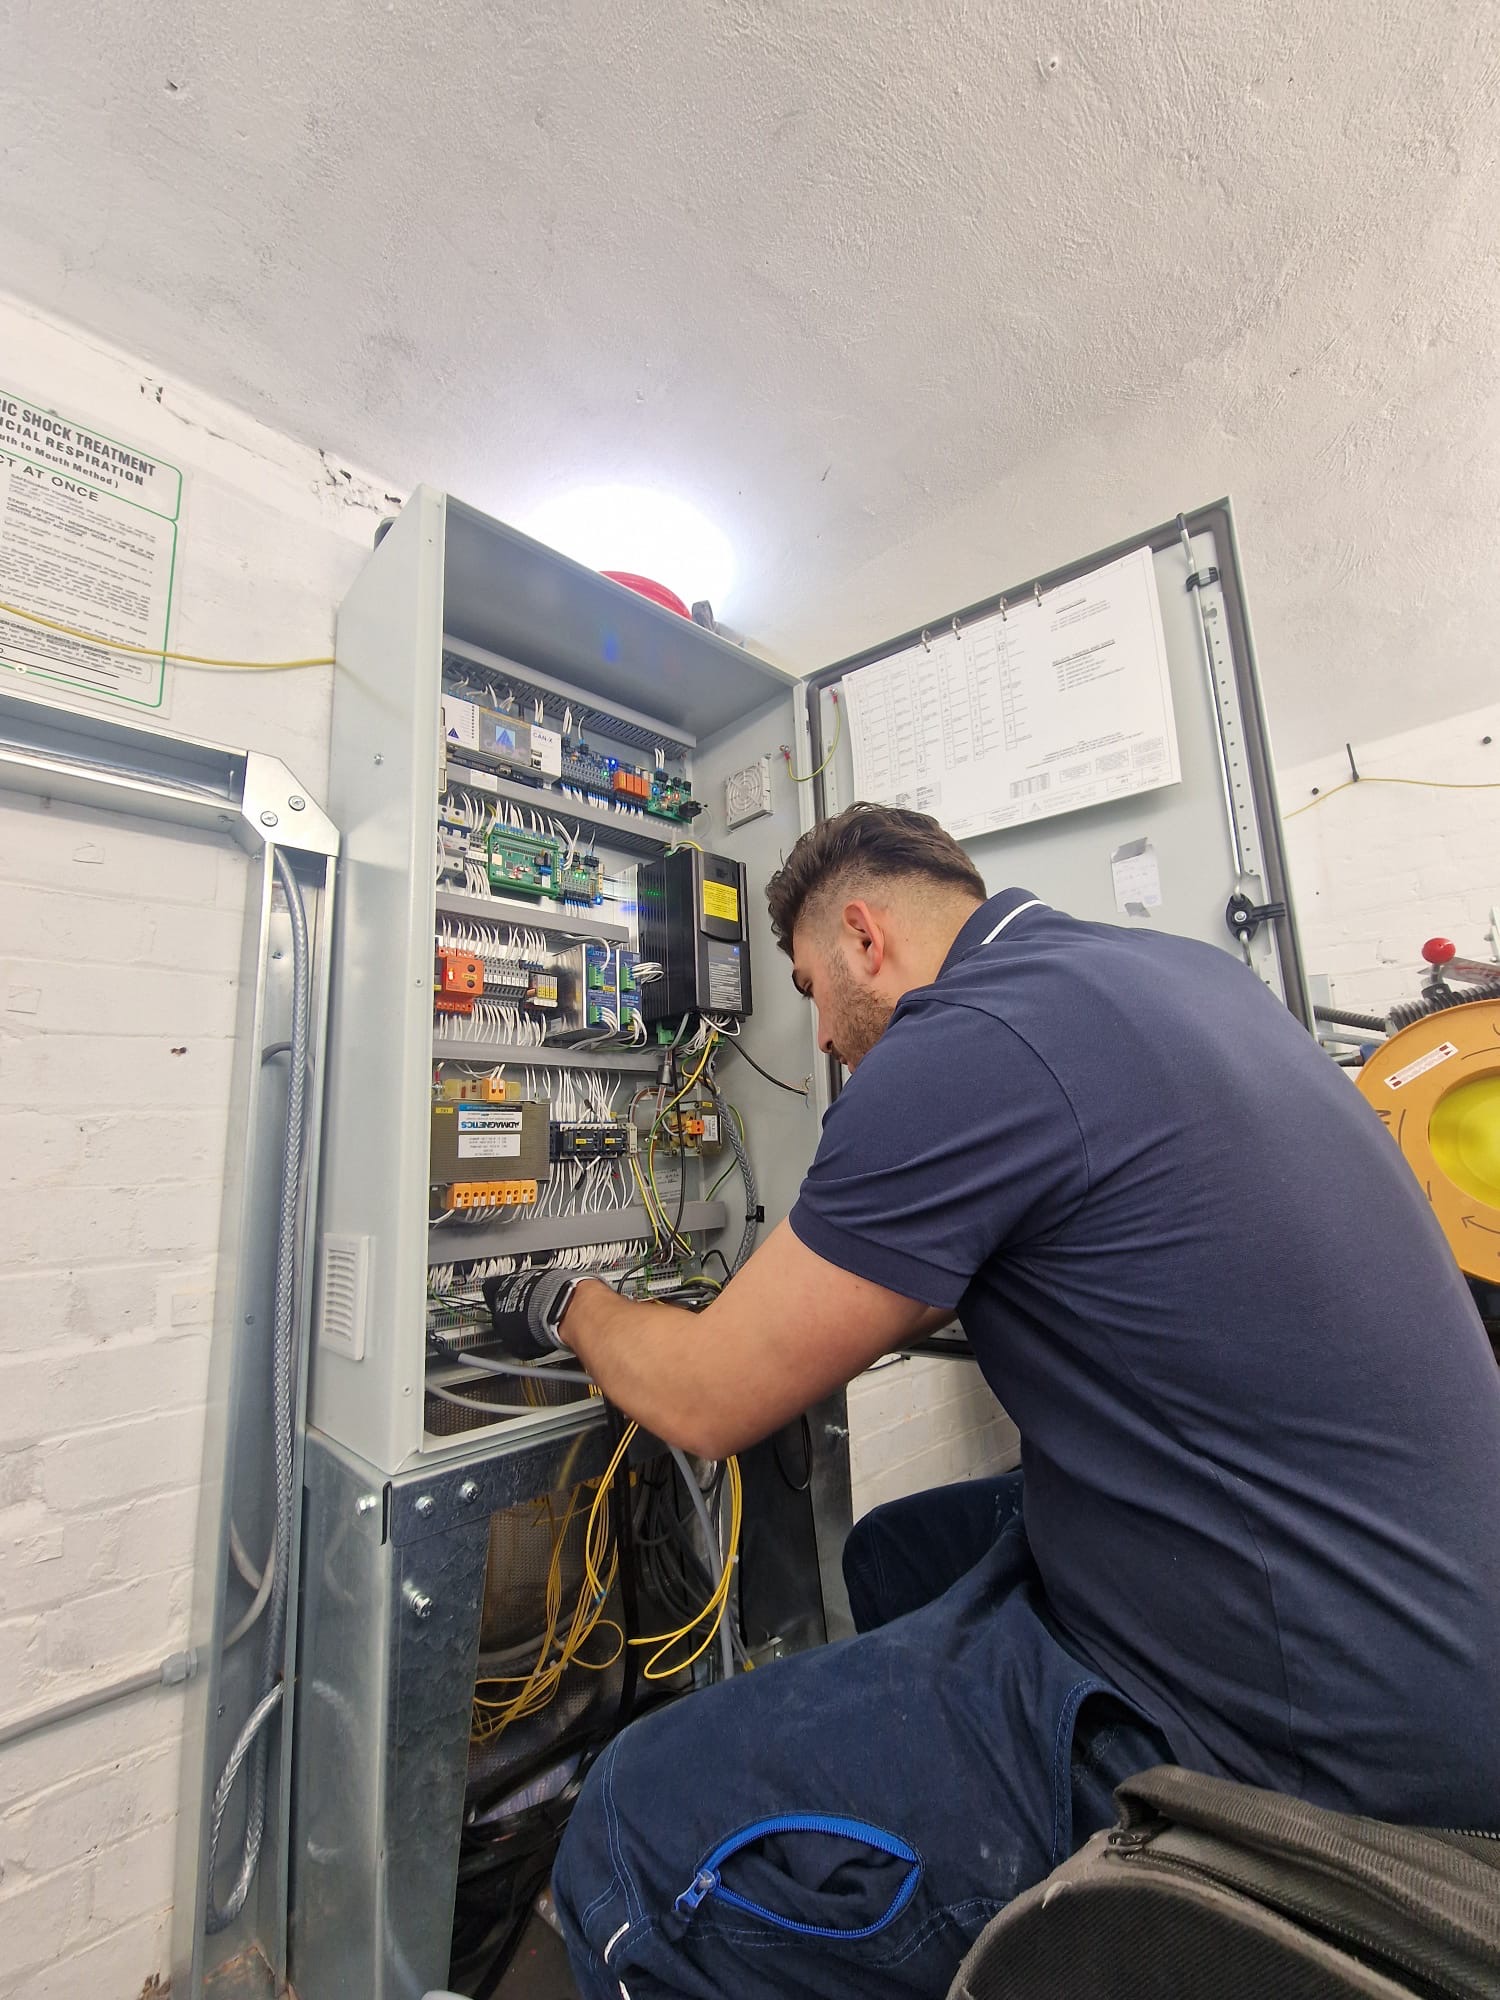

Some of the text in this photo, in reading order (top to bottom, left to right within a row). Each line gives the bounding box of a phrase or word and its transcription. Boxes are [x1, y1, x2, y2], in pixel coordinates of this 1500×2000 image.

[0, 398, 156, 477] IC SHOCK TREATMENT
[21, 441, 32, 452] to
[35, 447, 70, 467] Mouth
[73, 463, 113, 486] Method
[23, 465, 45, 480] AT
[51, 476, 99, 502] ONCE
[45, 437, 144, 486] RESPIRATION
